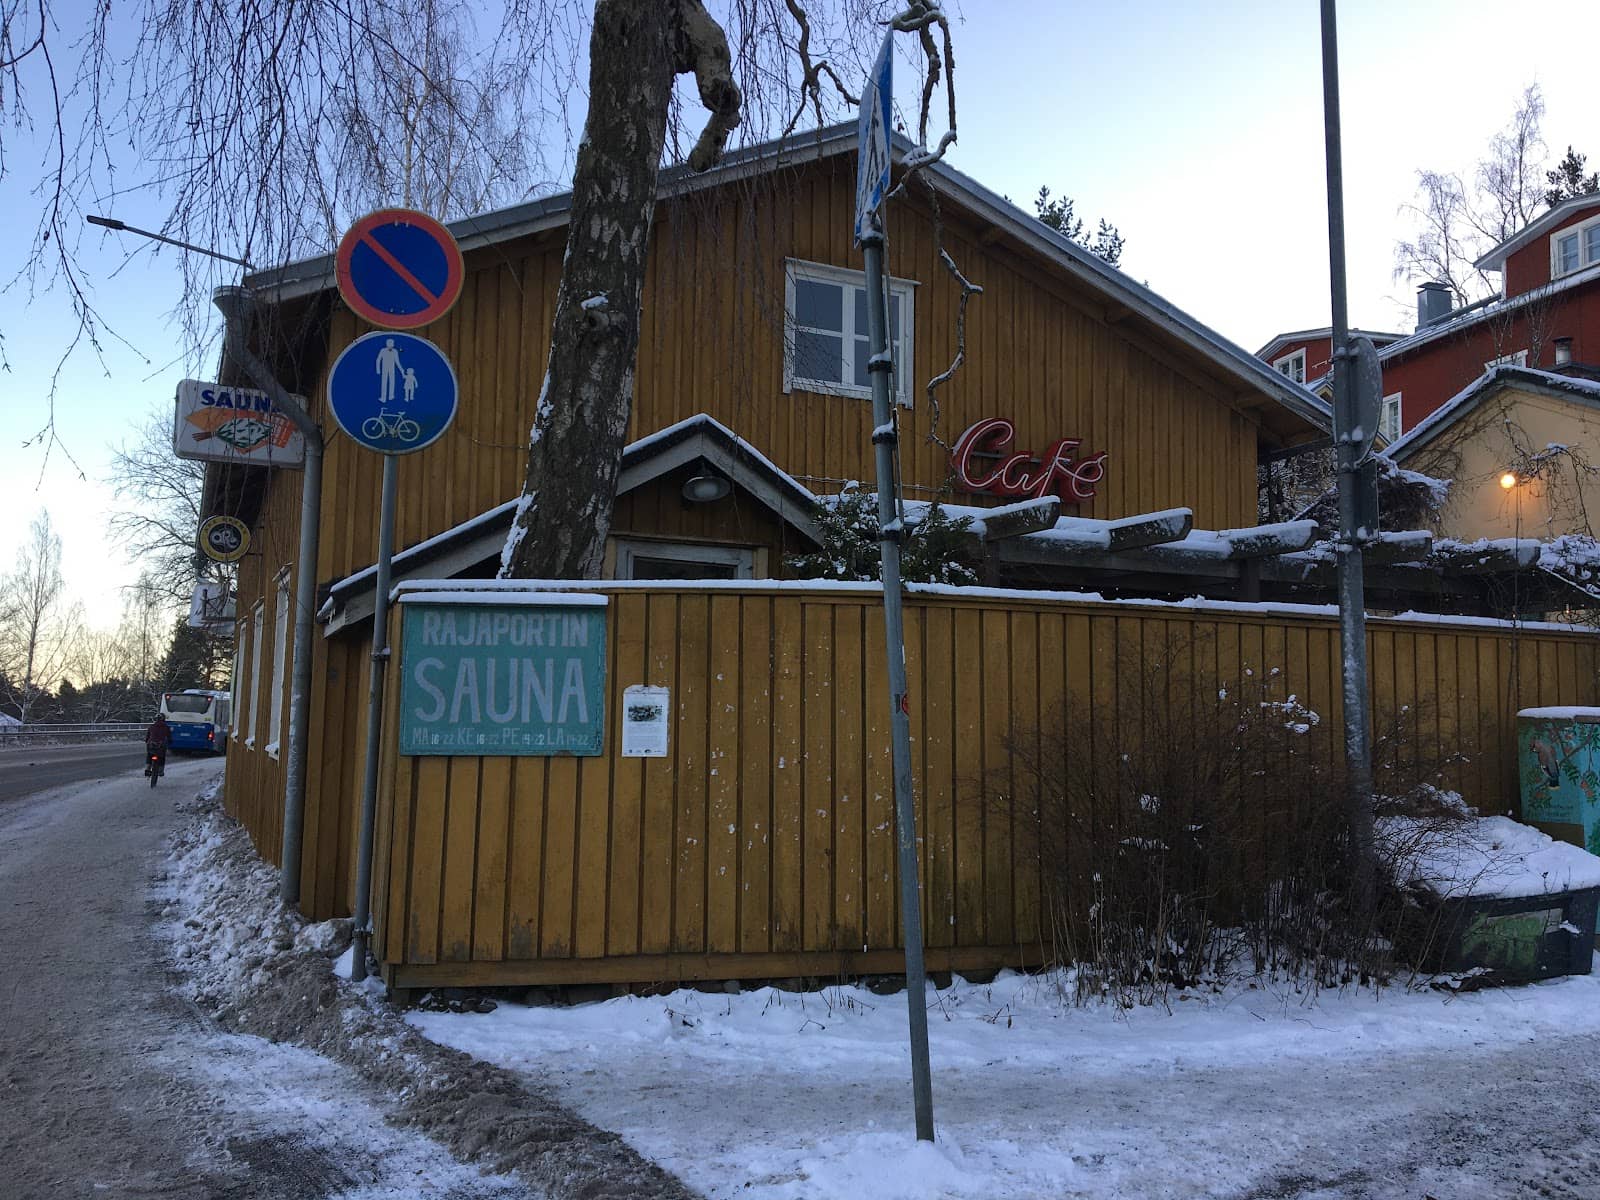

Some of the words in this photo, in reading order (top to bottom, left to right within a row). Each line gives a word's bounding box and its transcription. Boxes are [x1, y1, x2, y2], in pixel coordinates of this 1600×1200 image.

[201, 389, 282, 413] SAUN
[422, 612, 589, 647] RAJAPORTIN
[414, 658, 589, 723] SAUNA
[412, 727, 429, 744] MA
[458, 727, 475, 744] KE
[503, 727, 520, 744] PE
[547, 727, 564, 744] LA
